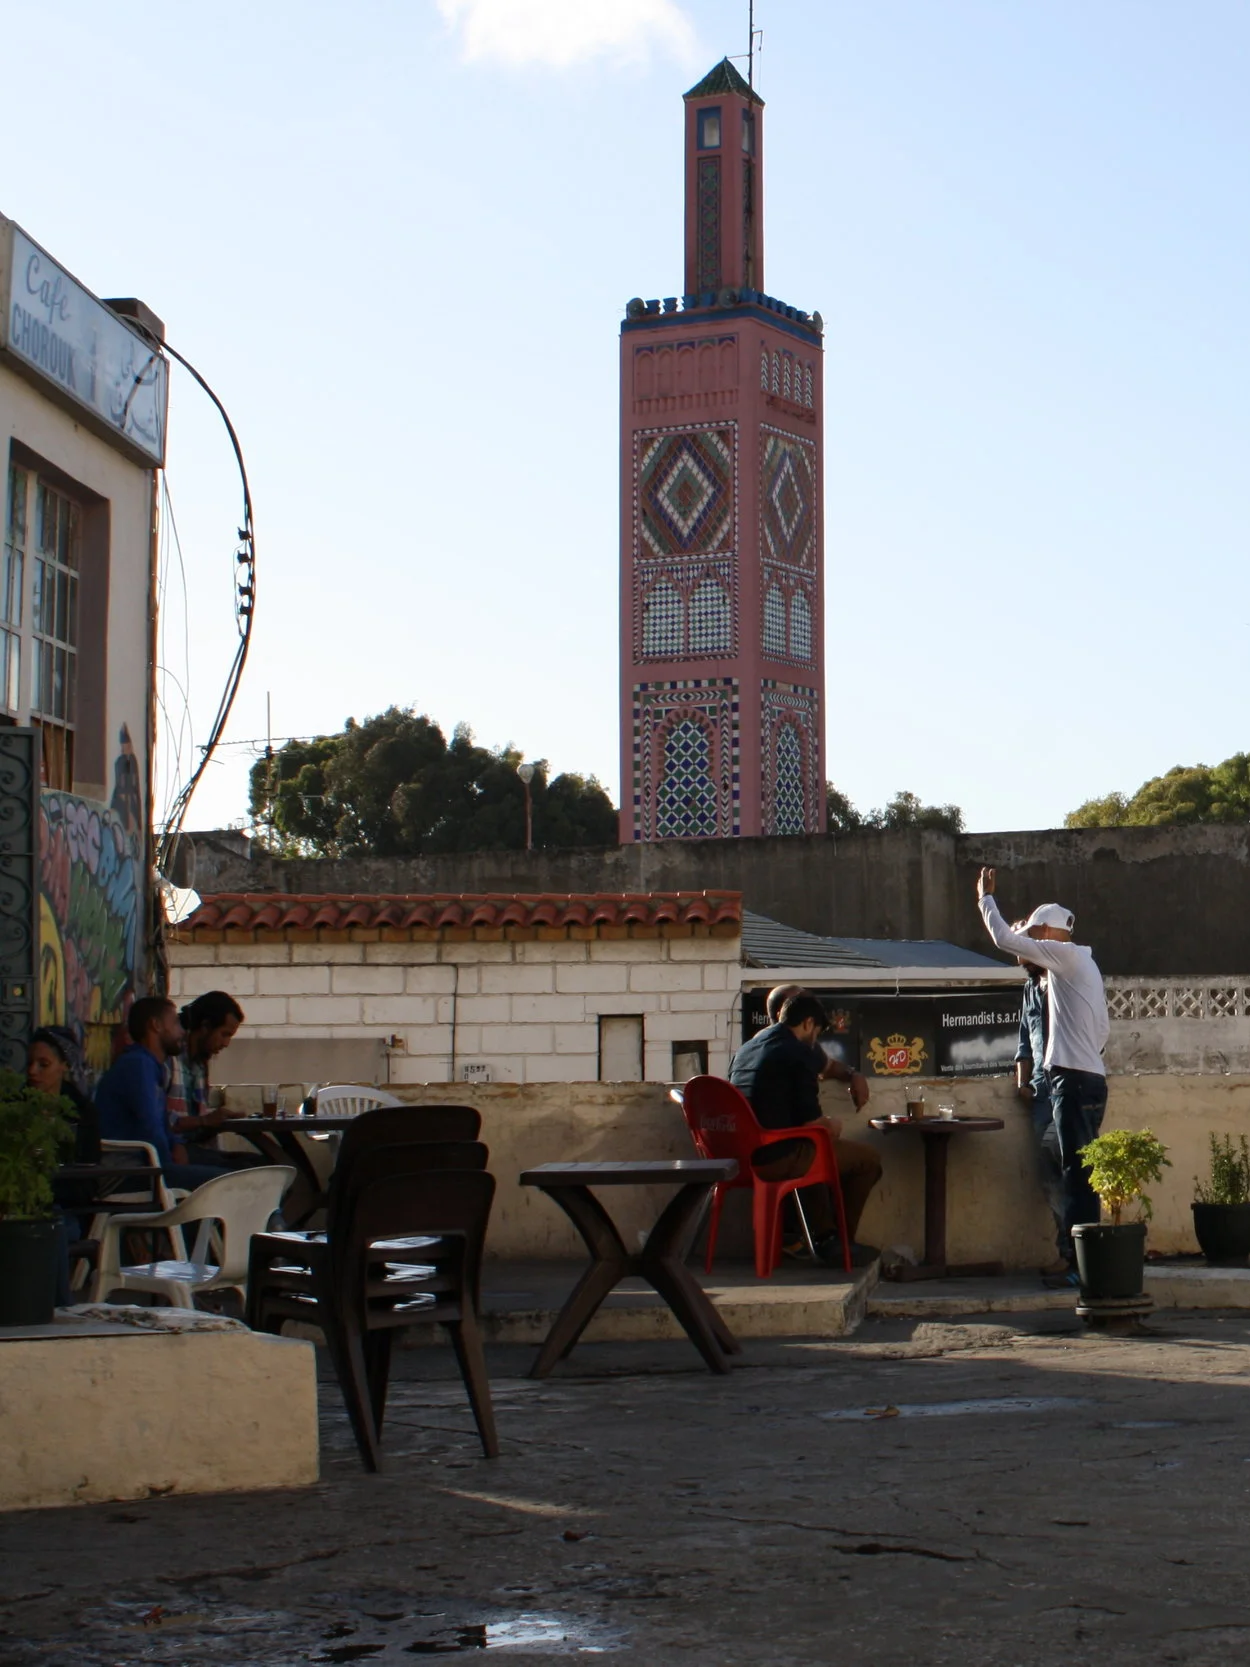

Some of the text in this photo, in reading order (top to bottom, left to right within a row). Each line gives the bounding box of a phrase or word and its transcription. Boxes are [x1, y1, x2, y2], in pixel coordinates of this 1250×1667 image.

[26, 252, 71, 324] Cafe
[11, 303, 77, 390] CHOROUK
[942, 1012, 995, 1028] Hermandist
